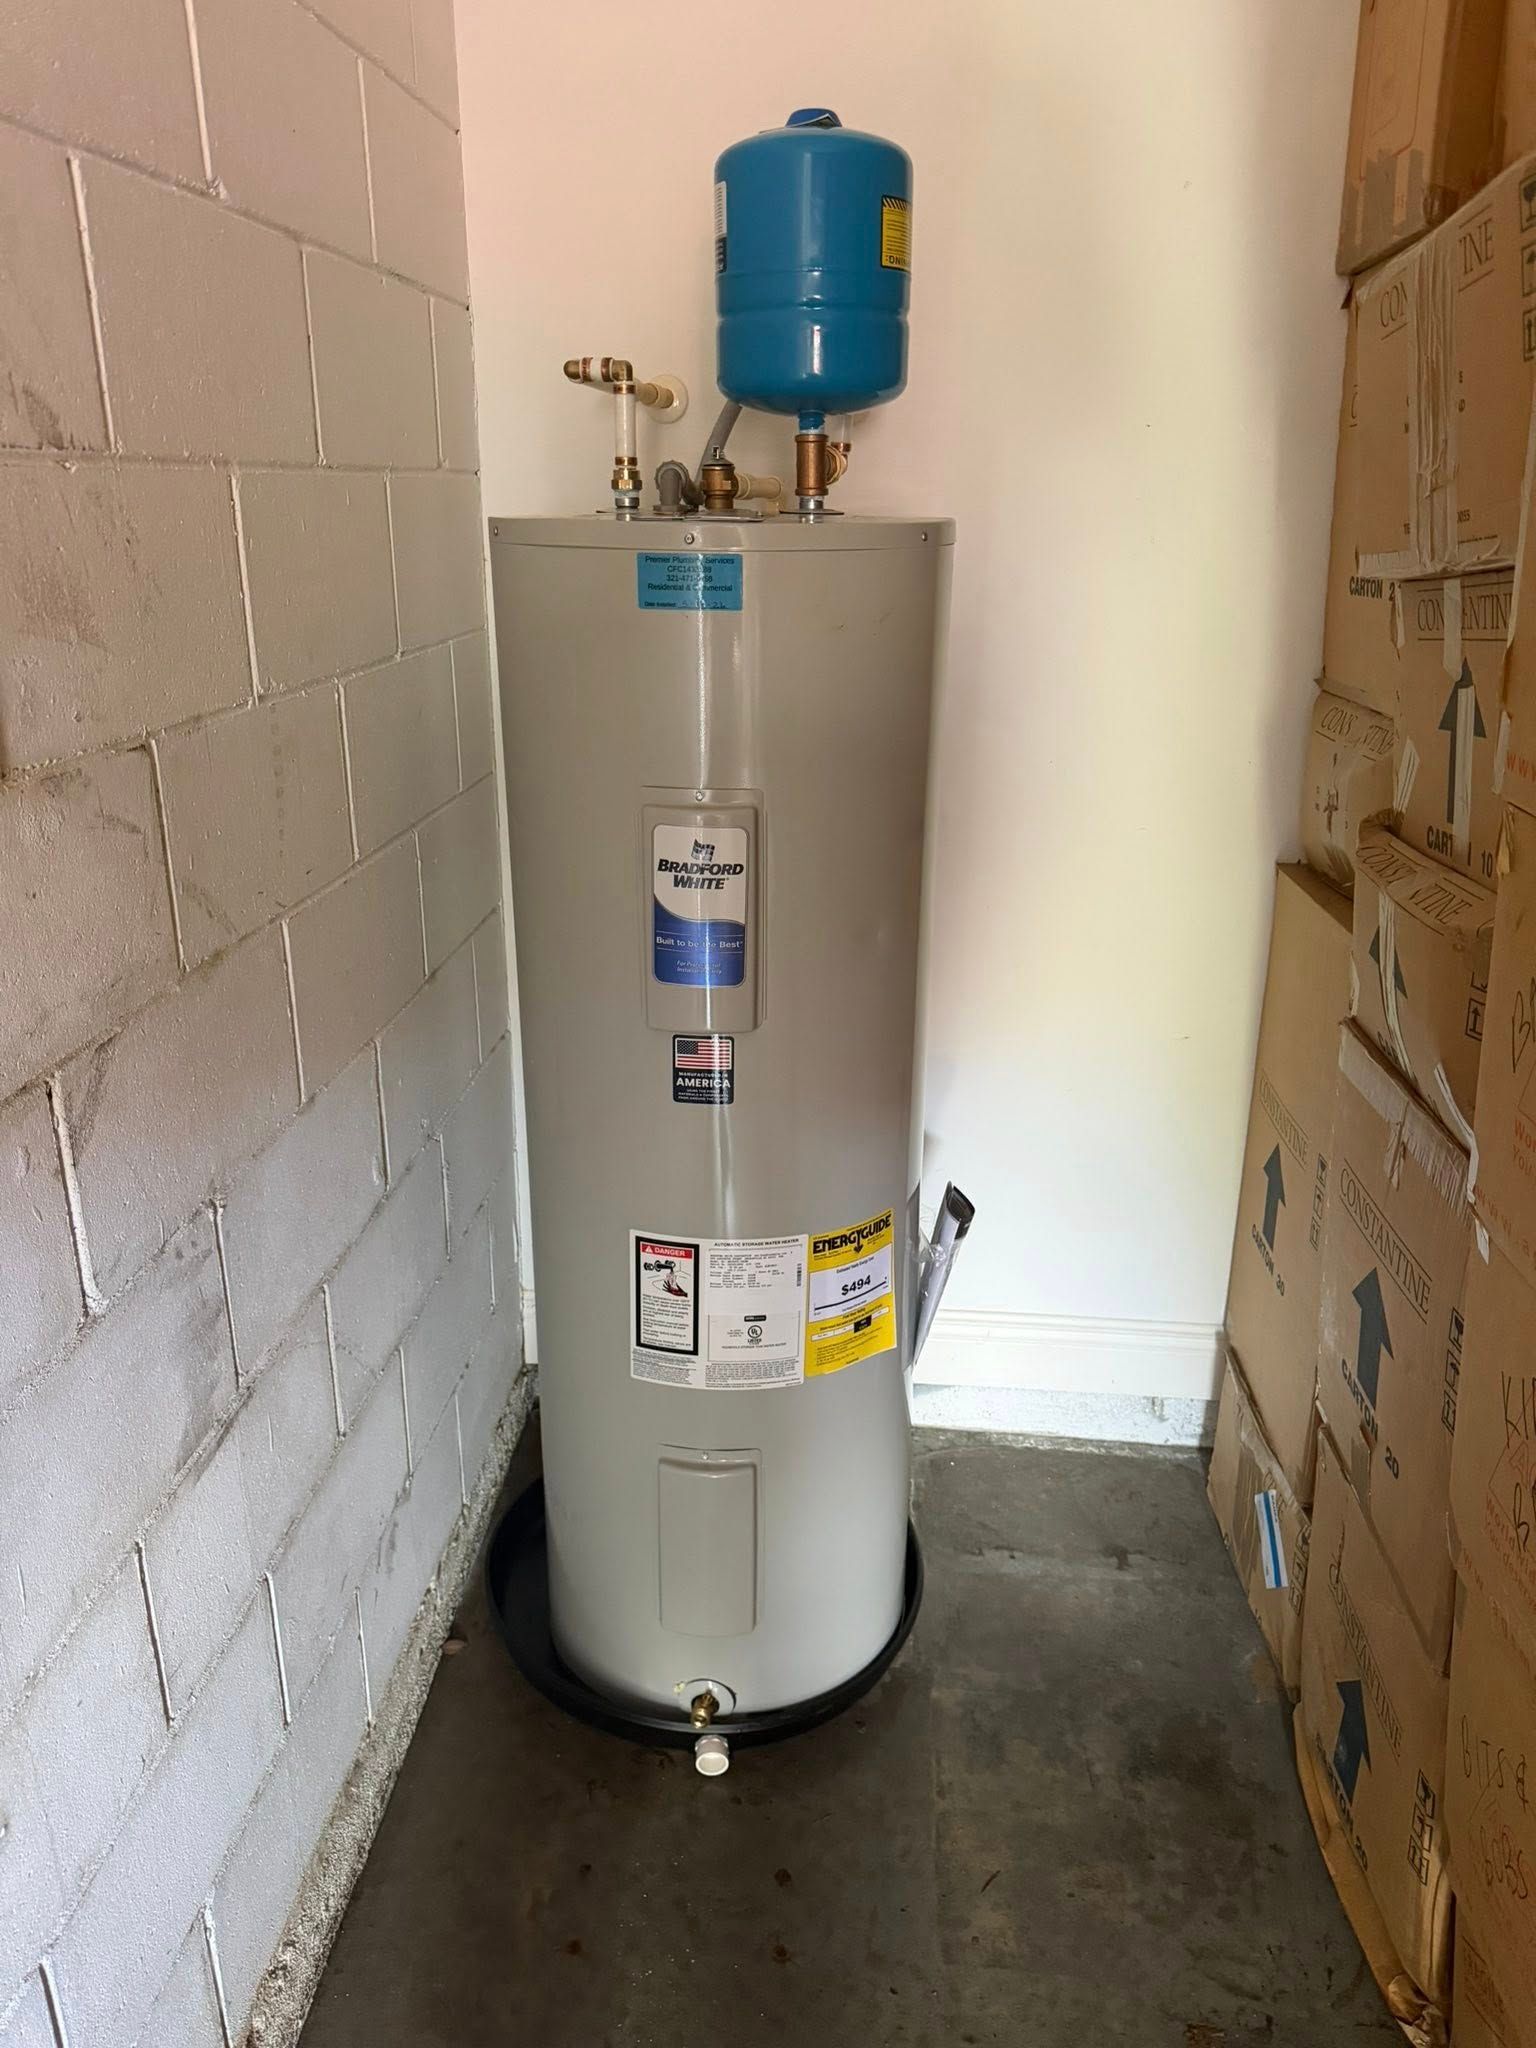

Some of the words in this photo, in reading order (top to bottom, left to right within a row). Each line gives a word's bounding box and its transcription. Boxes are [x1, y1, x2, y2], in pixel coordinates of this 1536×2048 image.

[1349, 576, 1383, 599] CARTON
[1388, 582, 1402, 601] 2
[657, 858, 745, 876] BRADFORD
[1481, 849, 1494, 879] 10
[672, 873, 726, 890] WHITE
[656, 936, 675, 946] Built
[676, 938, 686, 947] to
[688, 939, 700, 948] be
[676, 1077, 731, 1088] AMERICA
[813, 1213, 892, 1255] ENERGYGUIDE
[1340, 1168, 1431, 1315] CONSTANTINE
[654, 1247, 686, 1257] DANGER
[1251, 1223, 1275, 1286] CARTON
[840, 1274, 872, 1297] $494
[1341, 1357, 1379, 1443] CARTON
[1384, 1445, 1400, 1481] 20
